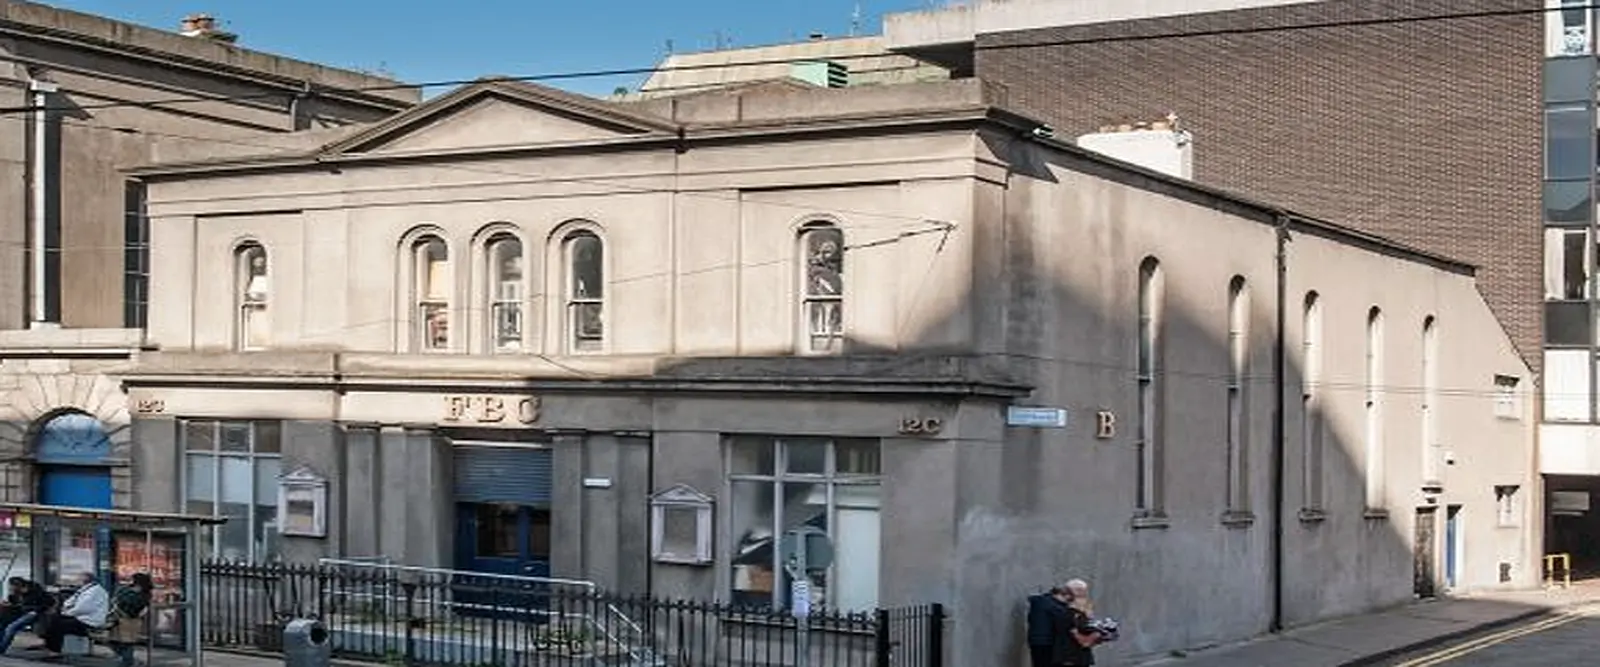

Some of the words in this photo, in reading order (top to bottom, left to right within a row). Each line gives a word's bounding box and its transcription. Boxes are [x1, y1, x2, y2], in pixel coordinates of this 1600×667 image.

[443, 395, 541, 424] FBC
[897, 416, 940, 435] 12C
[1096, 410, 1116, 438] B
